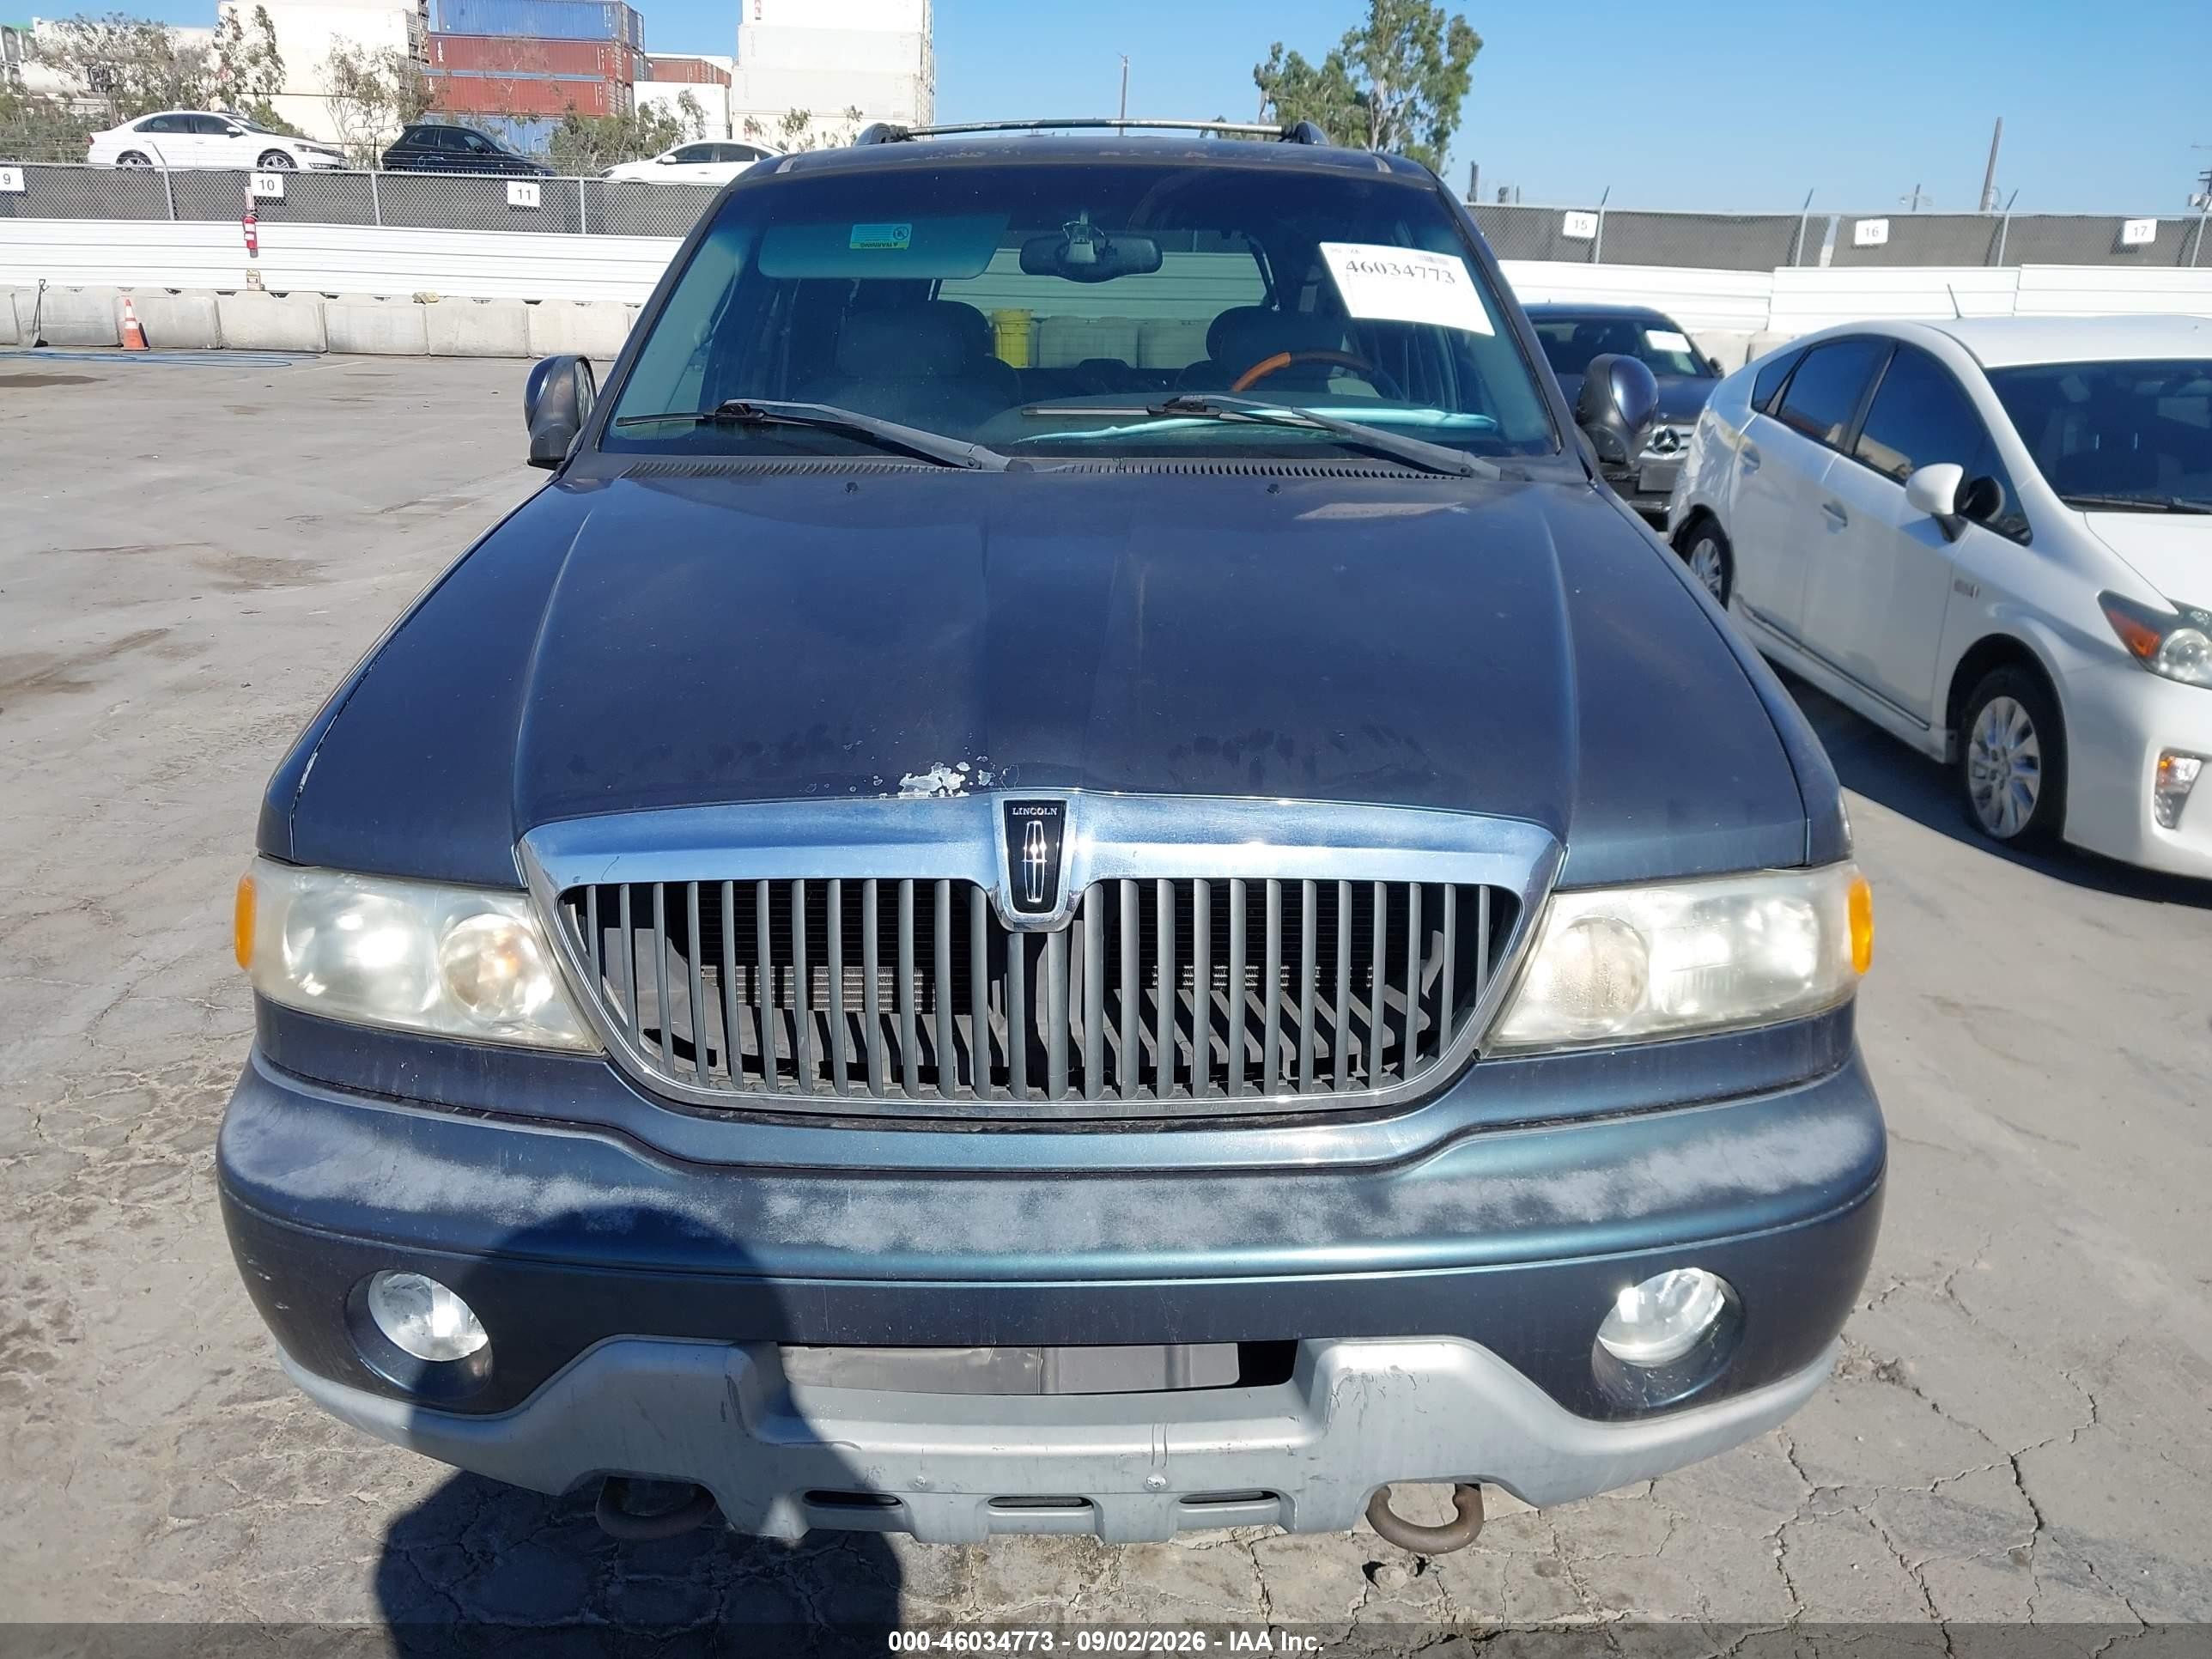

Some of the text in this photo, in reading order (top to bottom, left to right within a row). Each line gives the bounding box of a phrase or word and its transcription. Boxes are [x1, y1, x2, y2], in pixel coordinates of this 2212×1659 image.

[3, 173, 11, 185] 9
[258, 179, 275, 191] 10
[517, 189, 531, 200] 11
[1574, 219, 1588, 230] 15
[1865, 226, 1879, 237] 16
[2134, 225, 2148, 236] 17
[1346, 260, 1455, 284] 46034773
[1012, 807, 1058, 816] LINCOLN
